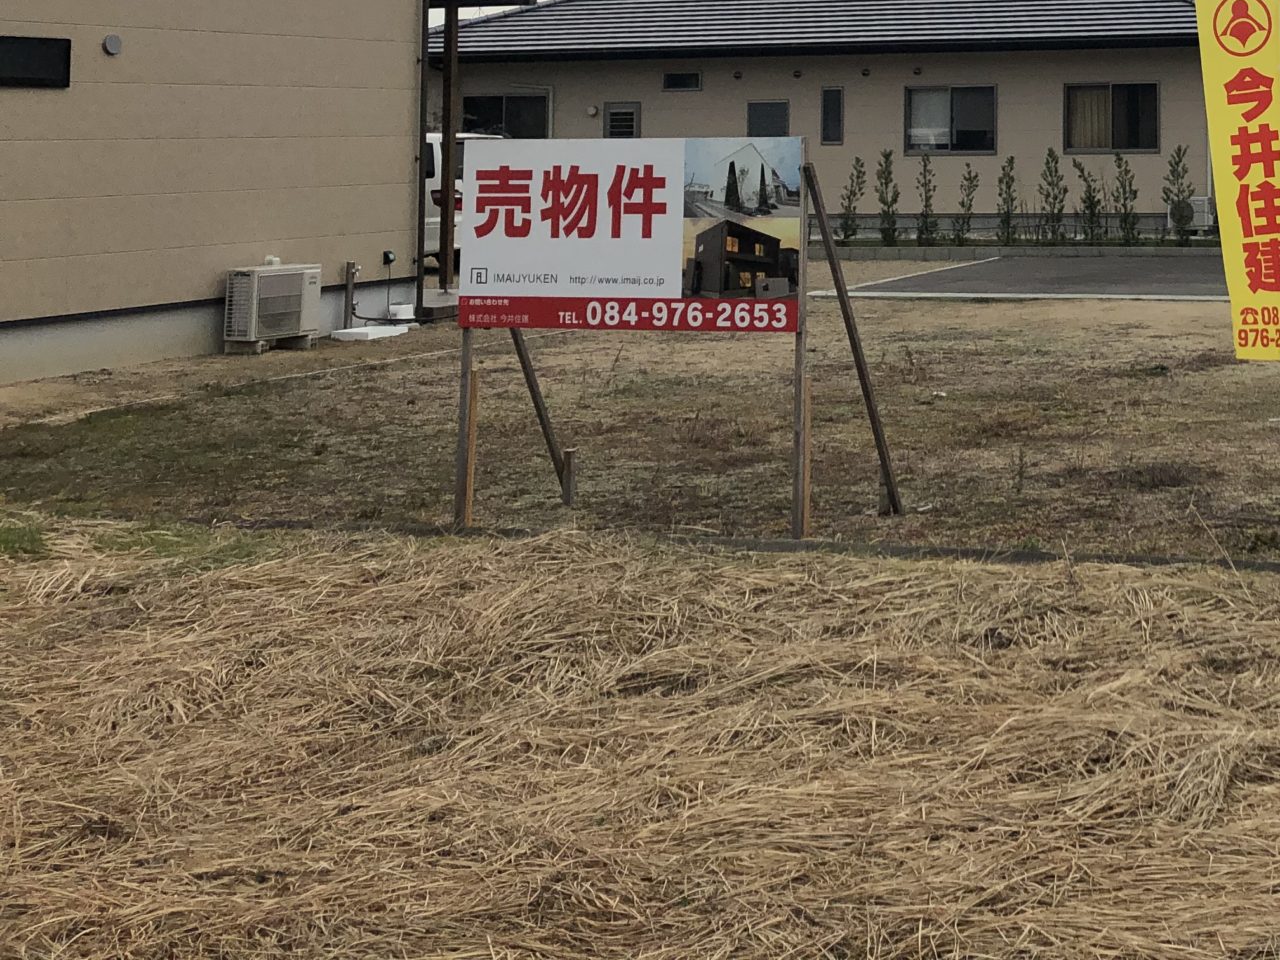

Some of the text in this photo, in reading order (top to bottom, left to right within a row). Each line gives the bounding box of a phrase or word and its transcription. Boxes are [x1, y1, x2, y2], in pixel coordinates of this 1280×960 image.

[474, 164, 667, 239] 売物件
[493, 273, 558, 284] IMAIJYUKEN
[558, 301, 787, 328] TEL. 084-976-2653
